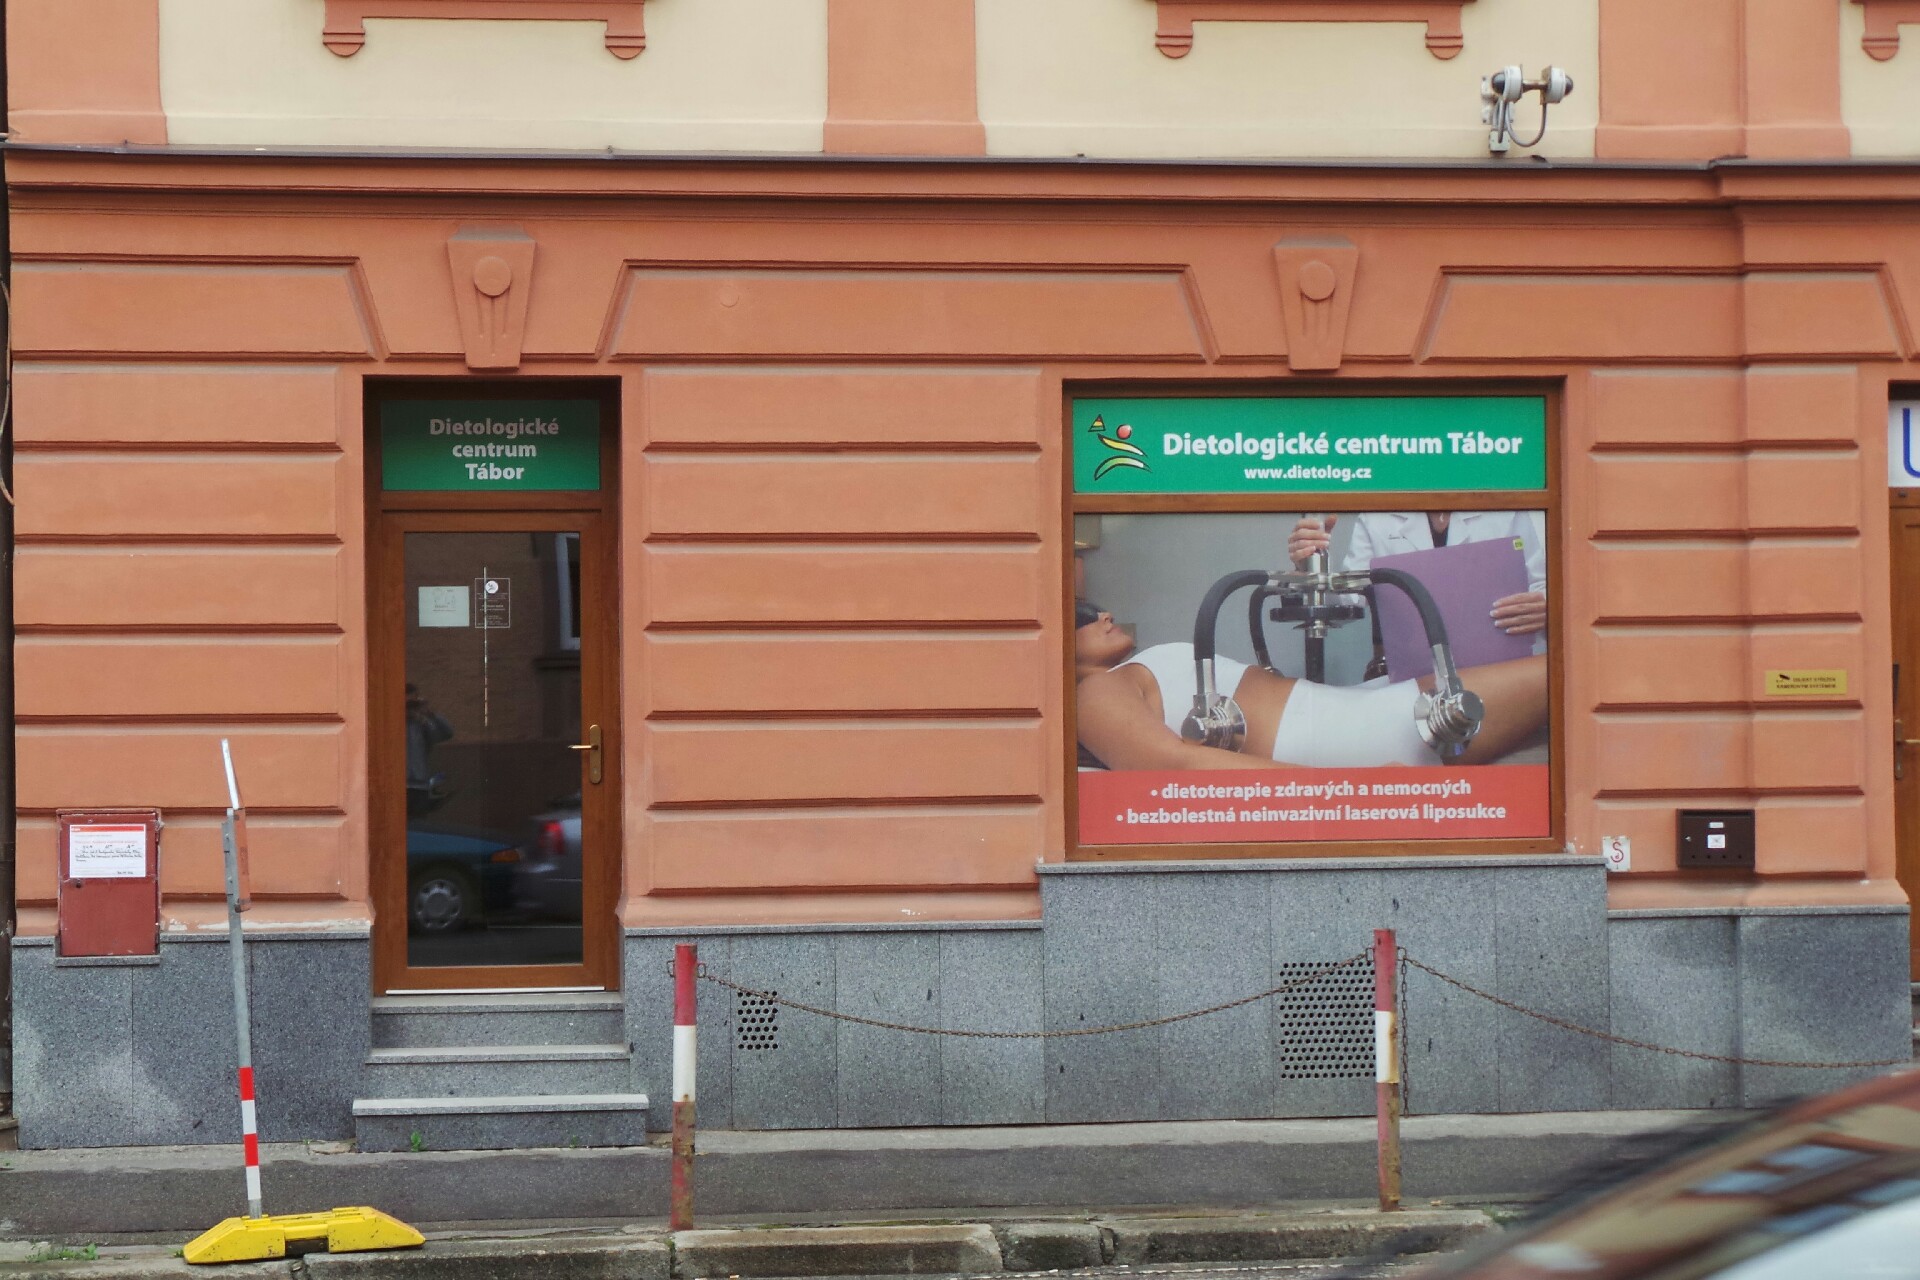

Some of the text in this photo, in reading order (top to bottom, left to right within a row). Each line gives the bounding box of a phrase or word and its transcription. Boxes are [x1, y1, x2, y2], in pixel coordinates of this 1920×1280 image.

[429, 418, 559, 439] Dietologické
[452, 442, 537, 458] centrum
[1163, 430, 1523, 460] Dietologické centrum Tábor
[464, 462, 525, 480] Tábor
[1244, 465, 1372, 483] www.dietolog.cz
[1161, 779, 1472, 801] dietoterapie zdravých a nemocných
[1127, 803, 1506, 824] bezbolestná neinvazivní laserová liposukce
